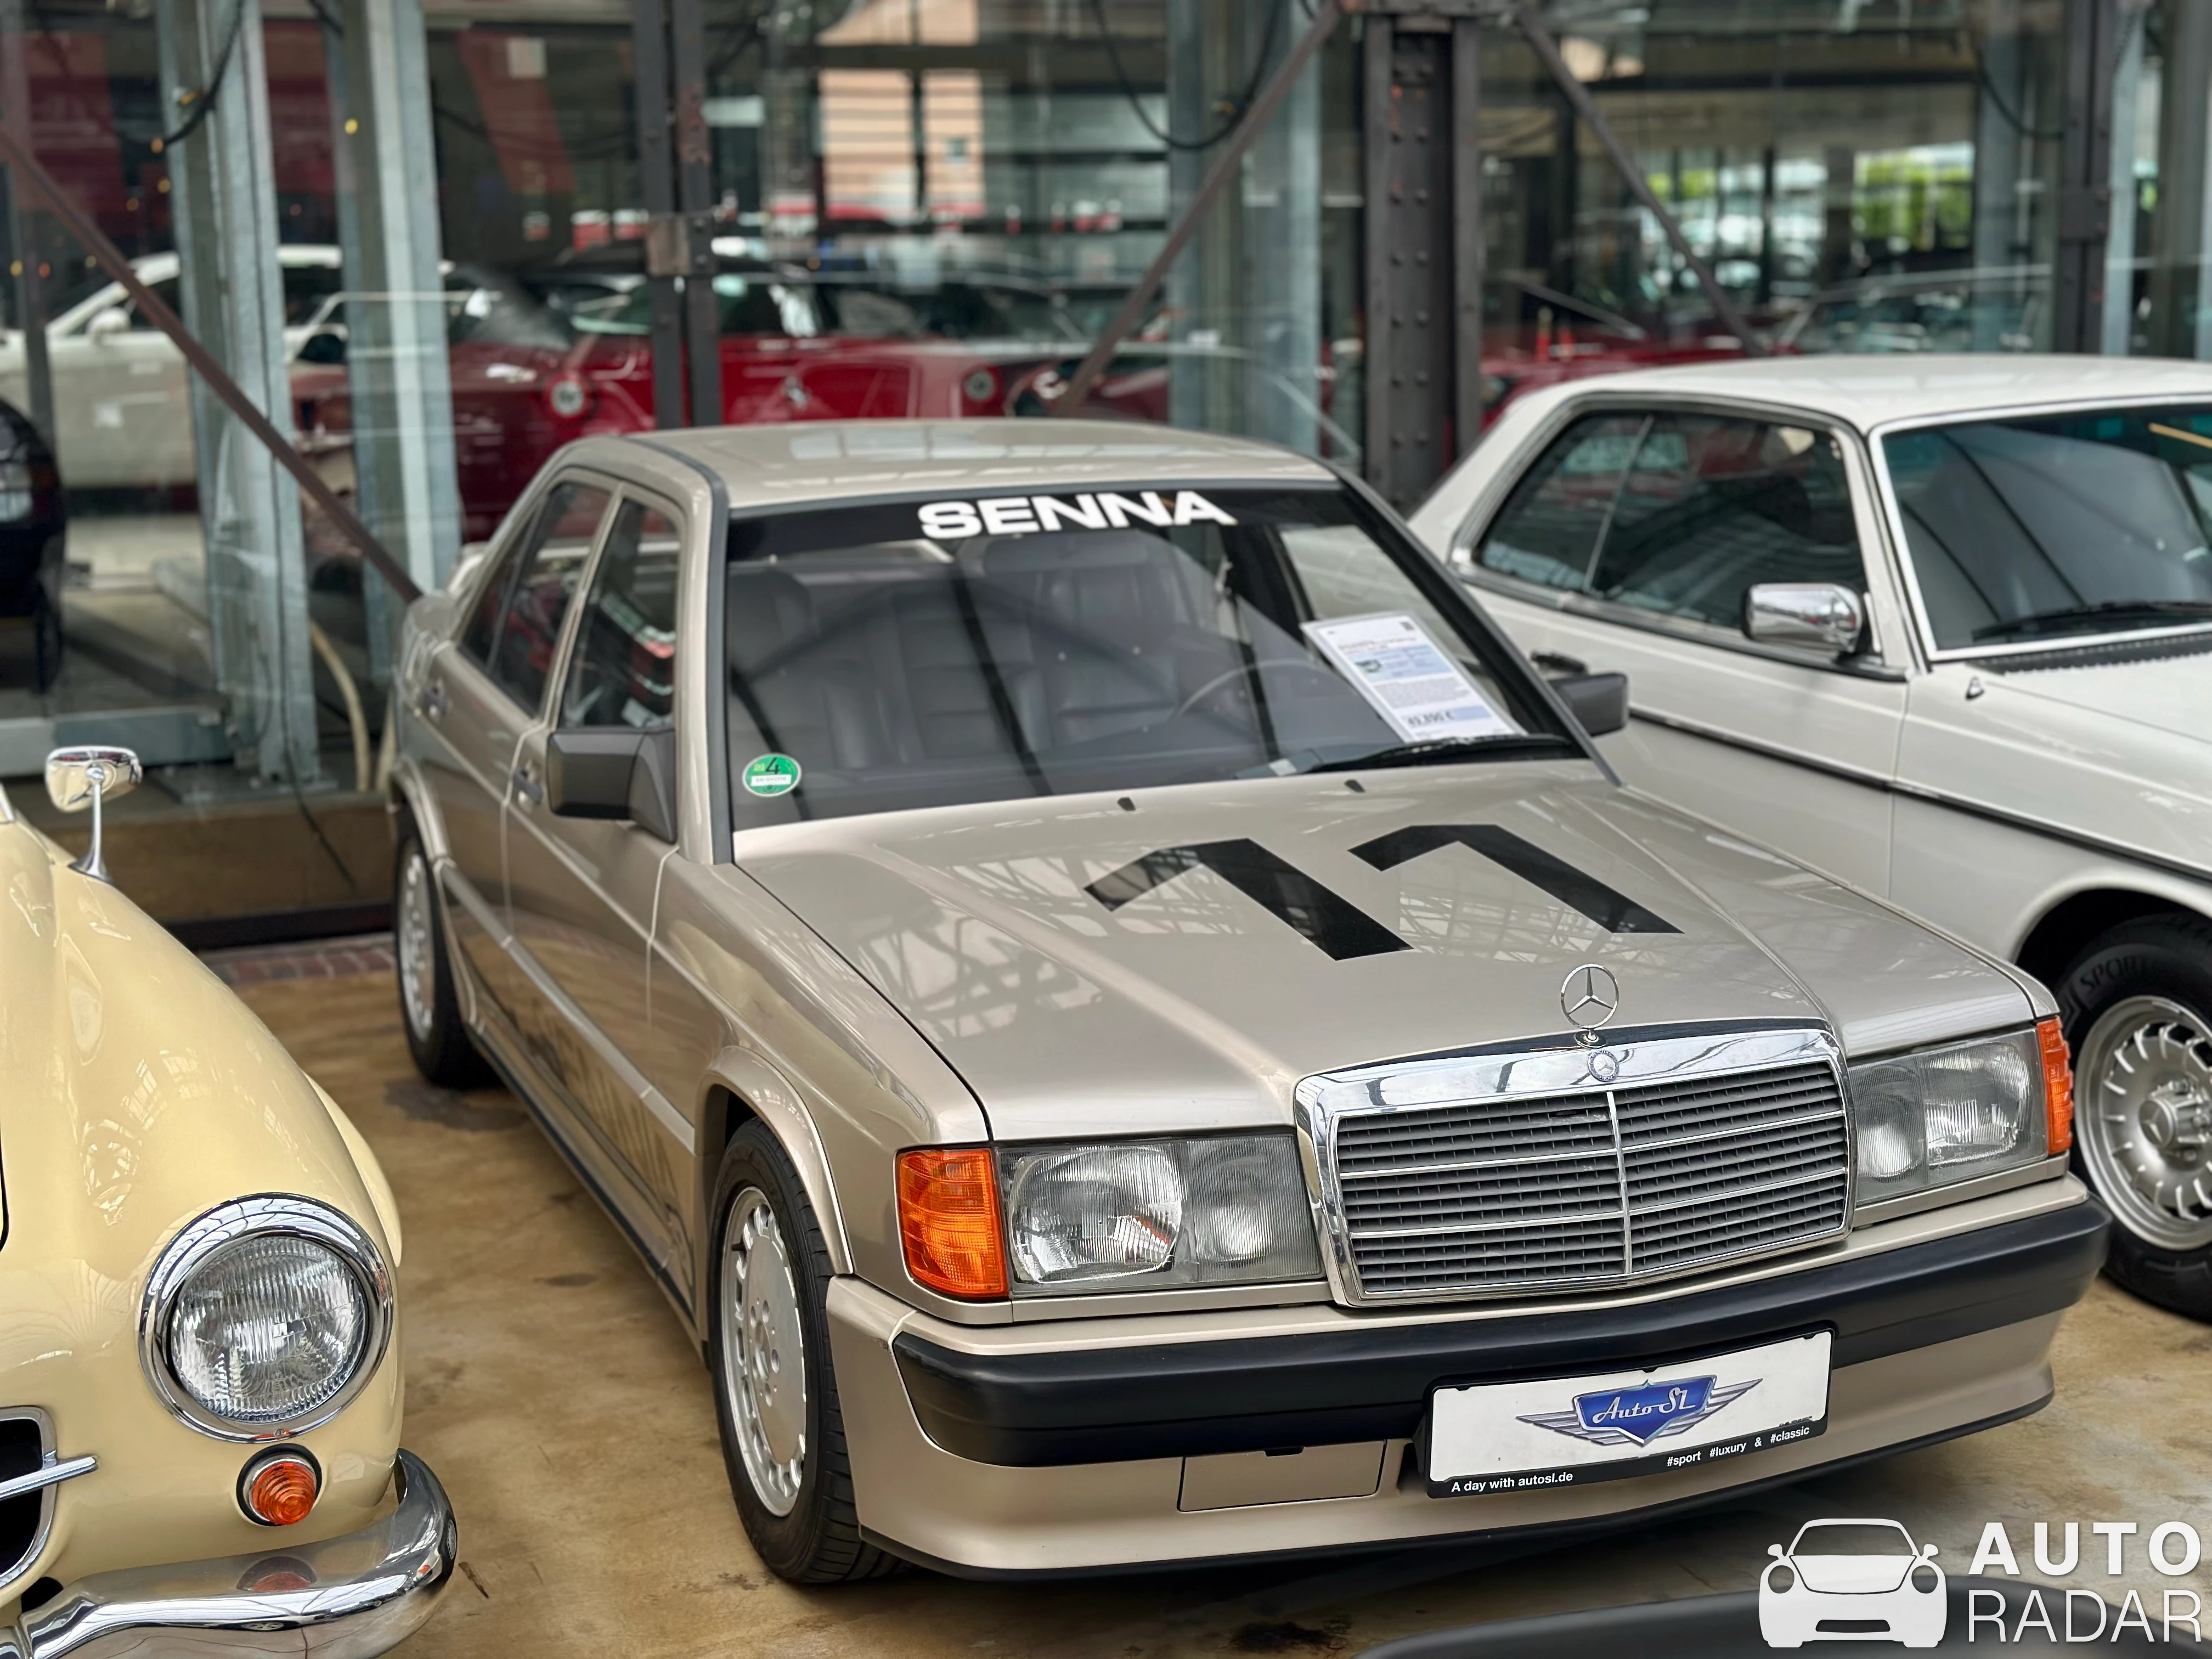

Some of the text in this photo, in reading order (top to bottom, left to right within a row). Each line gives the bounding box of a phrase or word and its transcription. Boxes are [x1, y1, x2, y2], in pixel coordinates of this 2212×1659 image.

[918, 491, 1239, 538] SENNA
[765, 757, 780, 775] 4
[1592, 1397, 1652, 1424] Auto
[1667, 1426, 1810, 1466] #sport #luxury & #classic
[1451, 1471, 1573, 1492] A day with autosl.de
